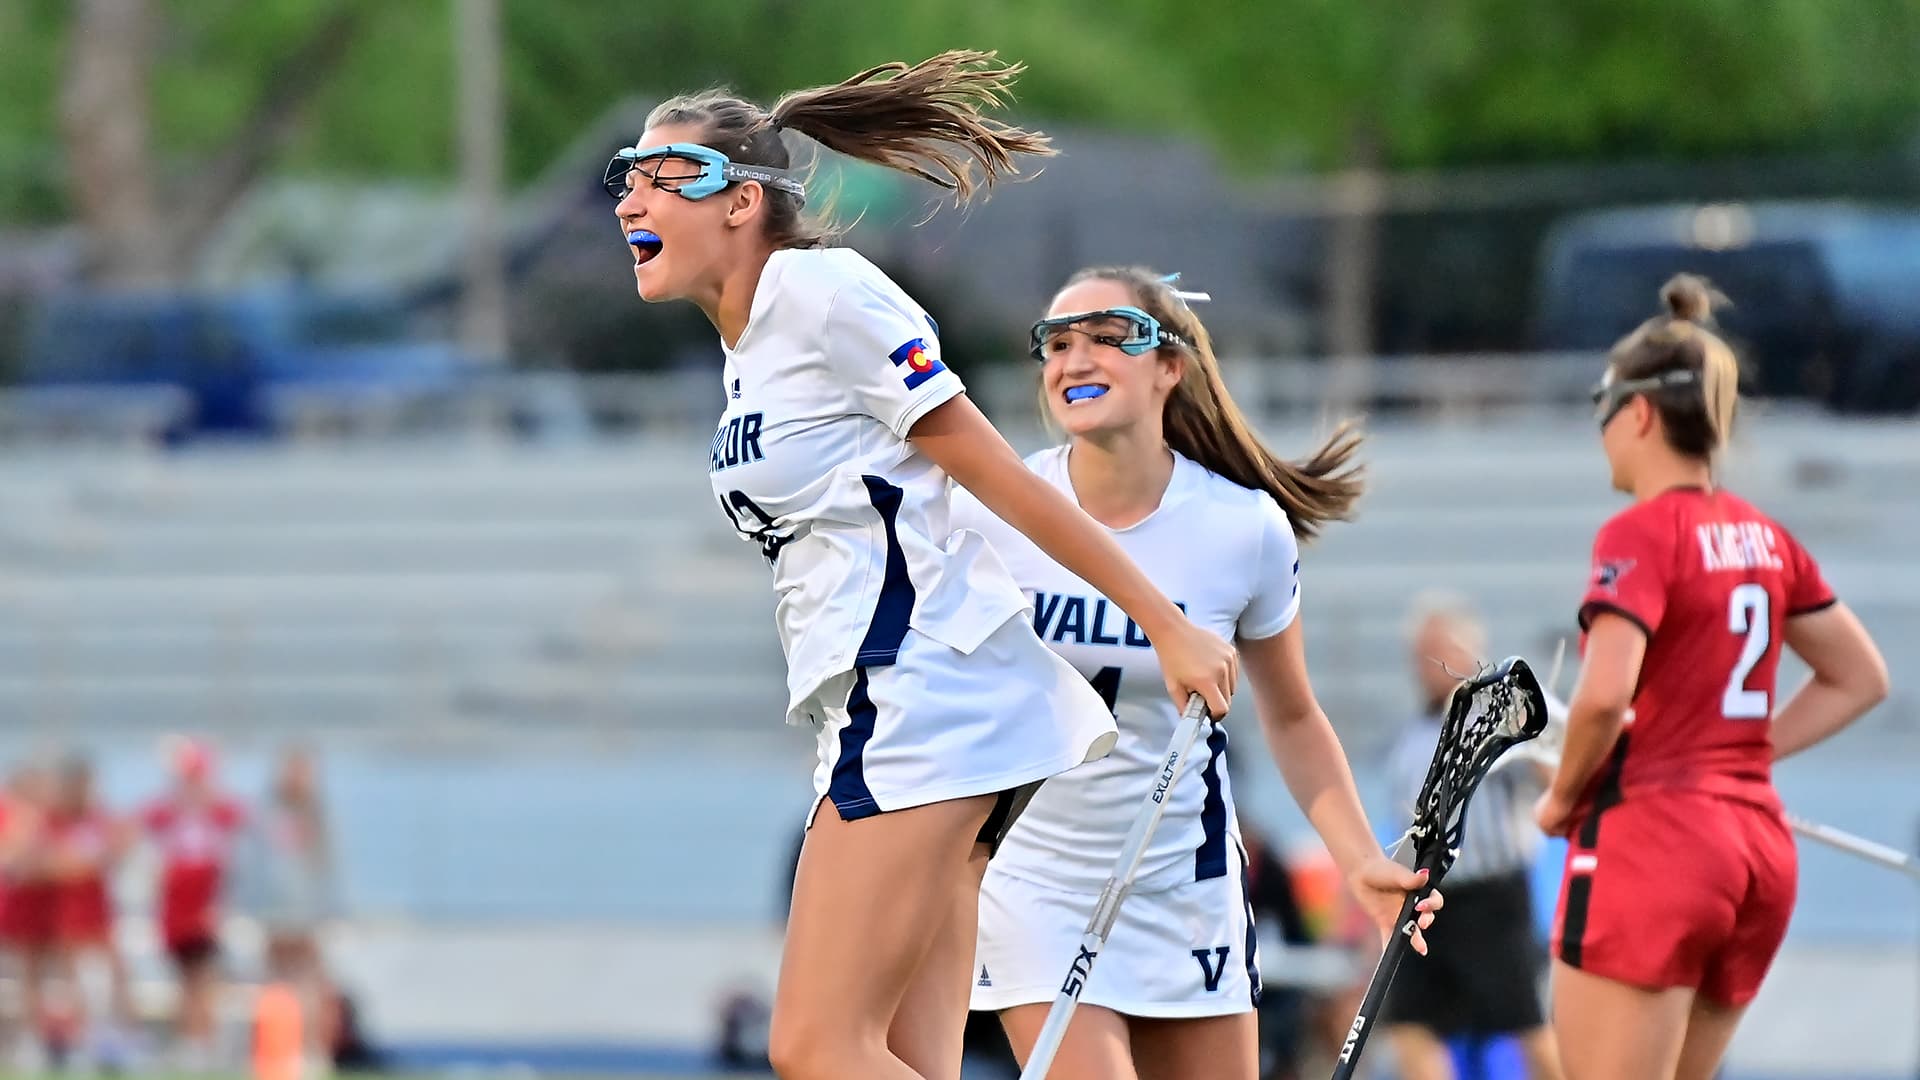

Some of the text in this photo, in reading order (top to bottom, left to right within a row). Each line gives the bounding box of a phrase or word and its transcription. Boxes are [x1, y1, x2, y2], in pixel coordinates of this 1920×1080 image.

[736, 169, 771, 182] UNDER
[1033, 592, 1186, 647] VALO
[1722, 583, 1769, 719] 2
[1152, 764, 1174, 804] EXULT
[1061, 944, 1097, 999] STX
[1191, 946, 1230, 991] V
[1339, 1015, 1366, 1065] GAIT
